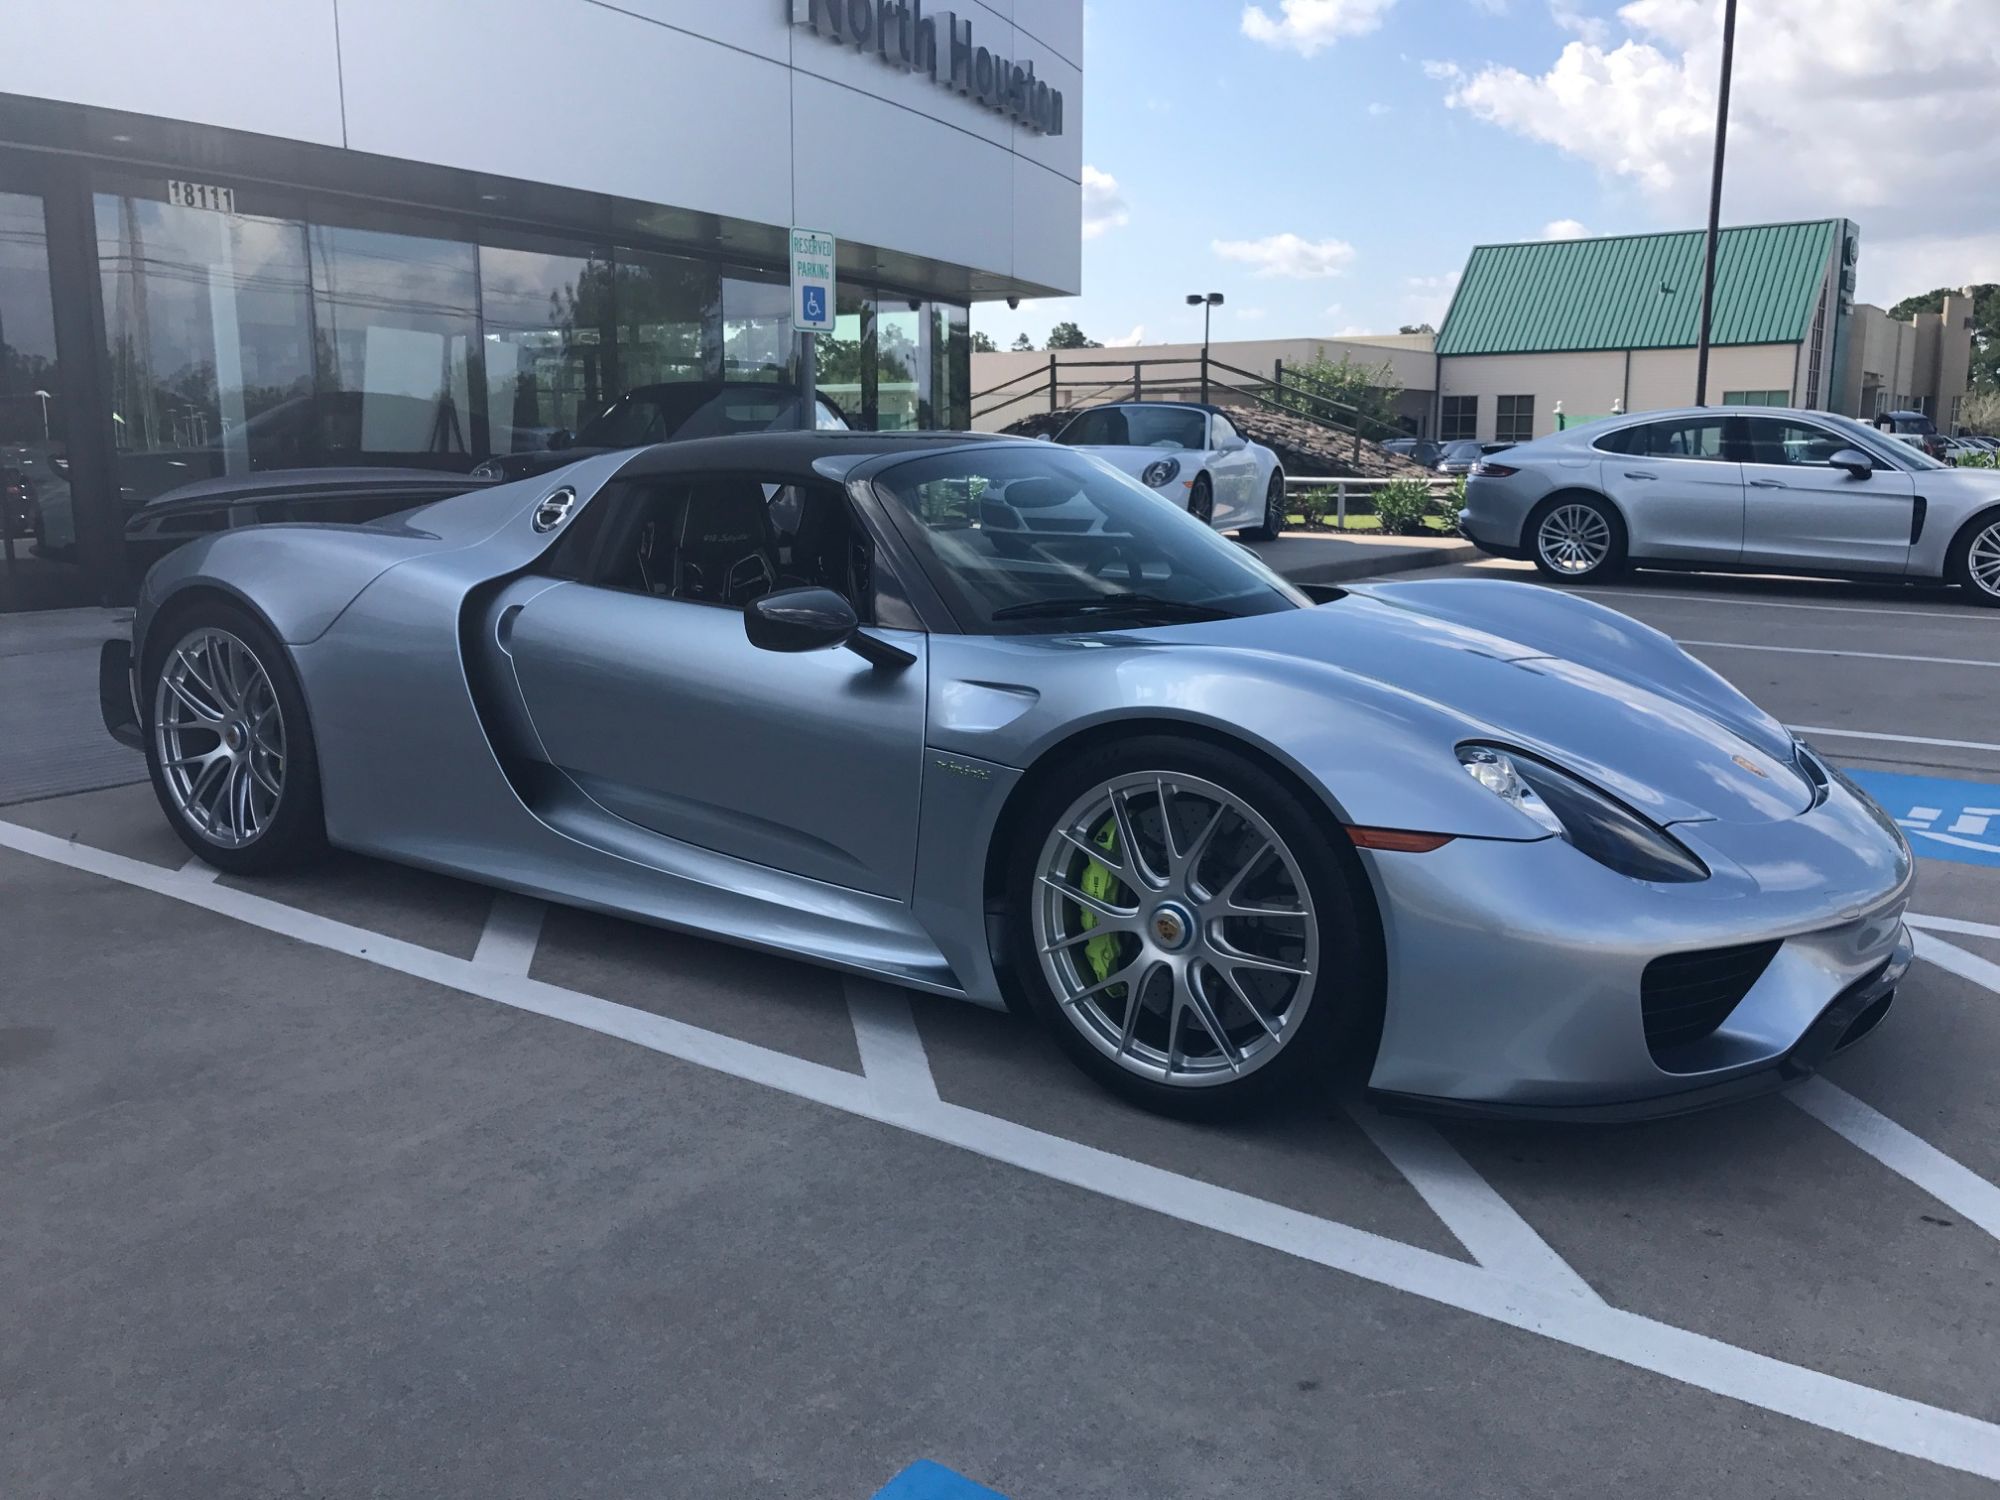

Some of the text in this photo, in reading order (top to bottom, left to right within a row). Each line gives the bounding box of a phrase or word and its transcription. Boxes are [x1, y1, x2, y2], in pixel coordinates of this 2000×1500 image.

[936, 11, 1063, 136] Houston
[171, 182, 232, 211] 18111
[794, 237, 831, 256] RESERVED
[798, 261, 829, 279] PARKING
